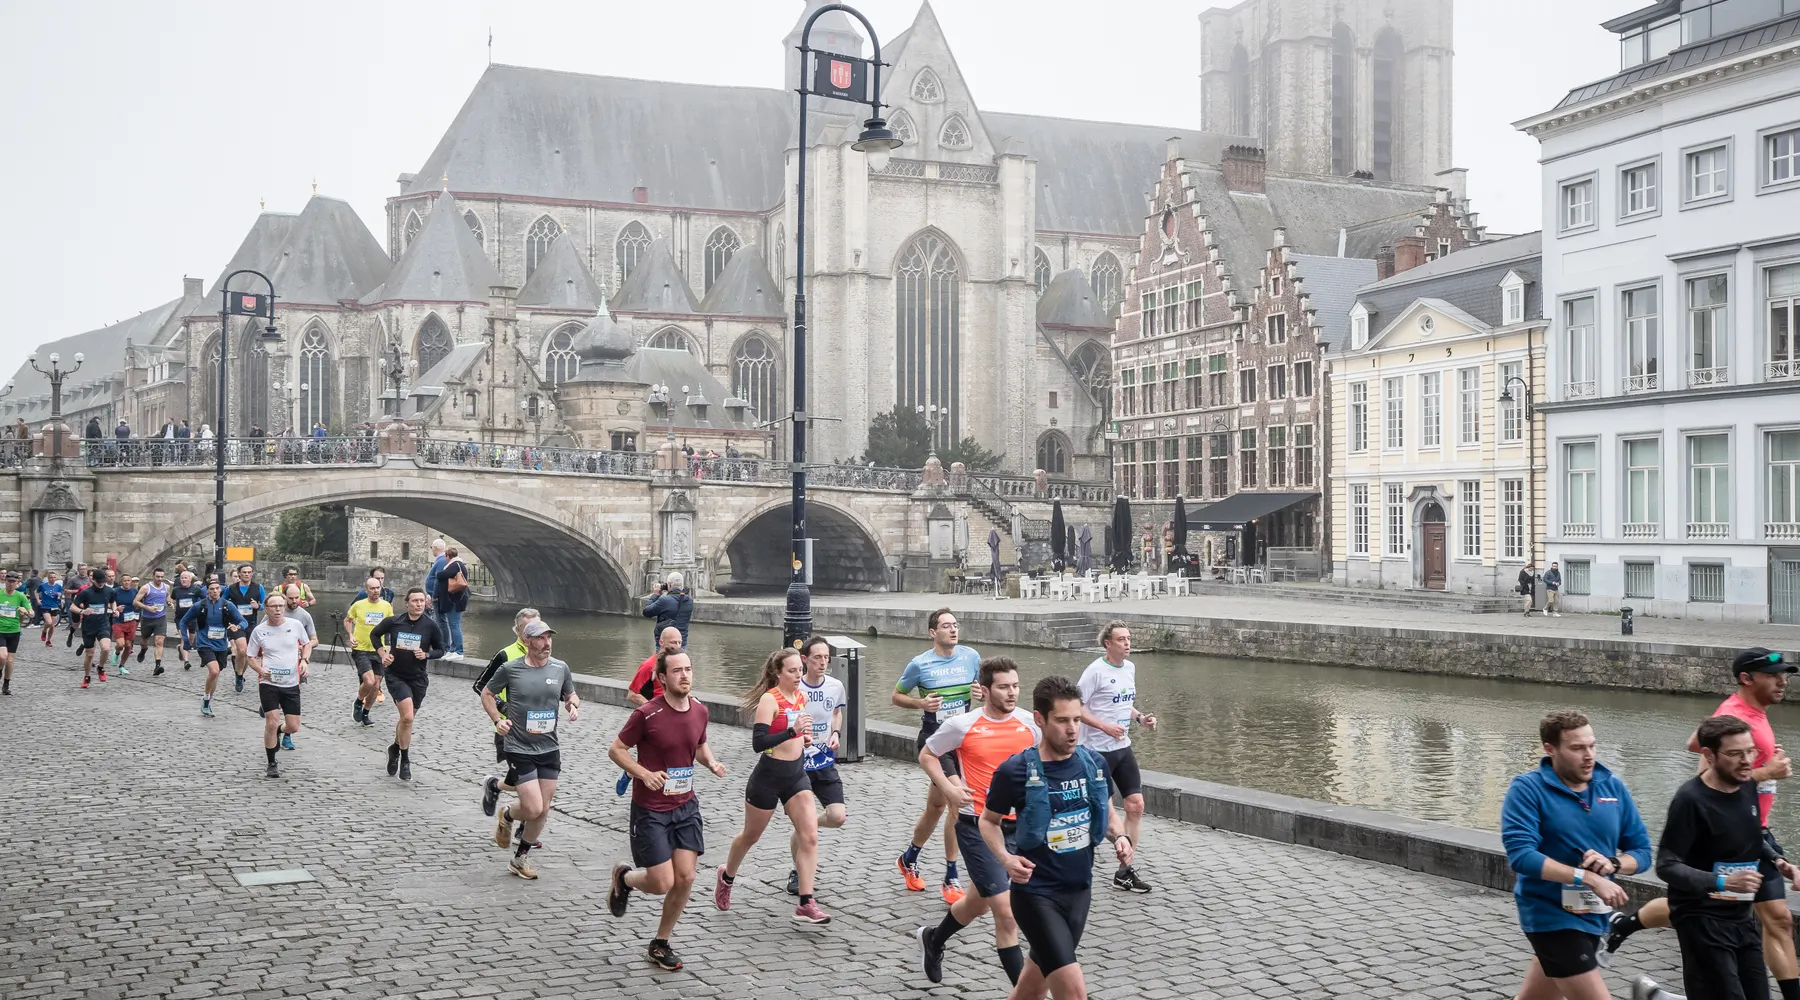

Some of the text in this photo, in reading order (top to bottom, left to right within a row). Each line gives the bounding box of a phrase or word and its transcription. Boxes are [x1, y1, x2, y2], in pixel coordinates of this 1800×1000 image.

[807, 691, 824, 702] ROB
[940, 699, 963, 709] OFICO
[668, 769, 693, 777] SOFIC
[1049, 810, 1091, 828] SOFICO
[1066, 828, 1081, 837] 627
[1067, 835, 1083, 843] Bart
